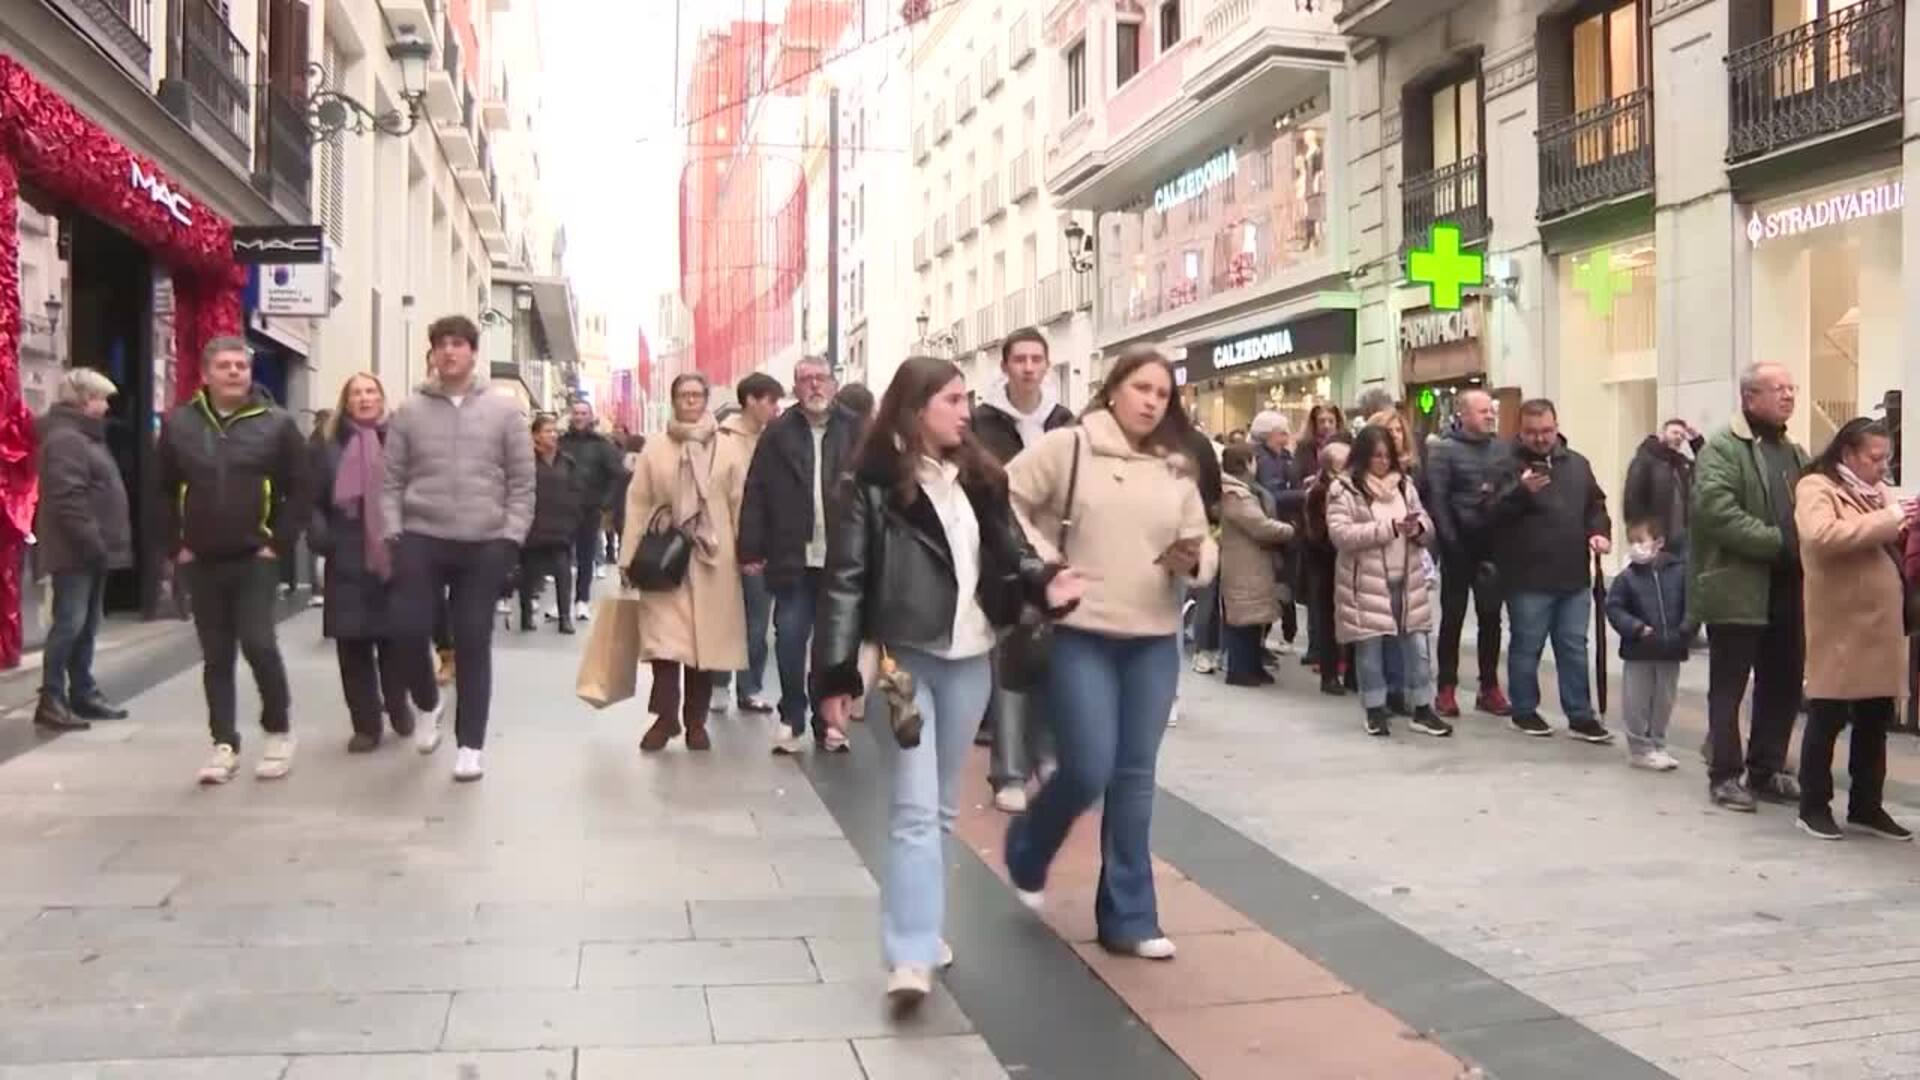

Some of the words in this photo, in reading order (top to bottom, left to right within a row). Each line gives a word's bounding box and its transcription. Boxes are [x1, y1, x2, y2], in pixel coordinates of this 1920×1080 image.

[129, 157, 192, 227] MAC
[1155, 148, 1237, 214] CALZEDONIA
[234, 239, 319, 251] MAC
[1213, 328, 1293, 369] CALZEDONIA
[1399, 309, 1475, 351] FARMACIA
